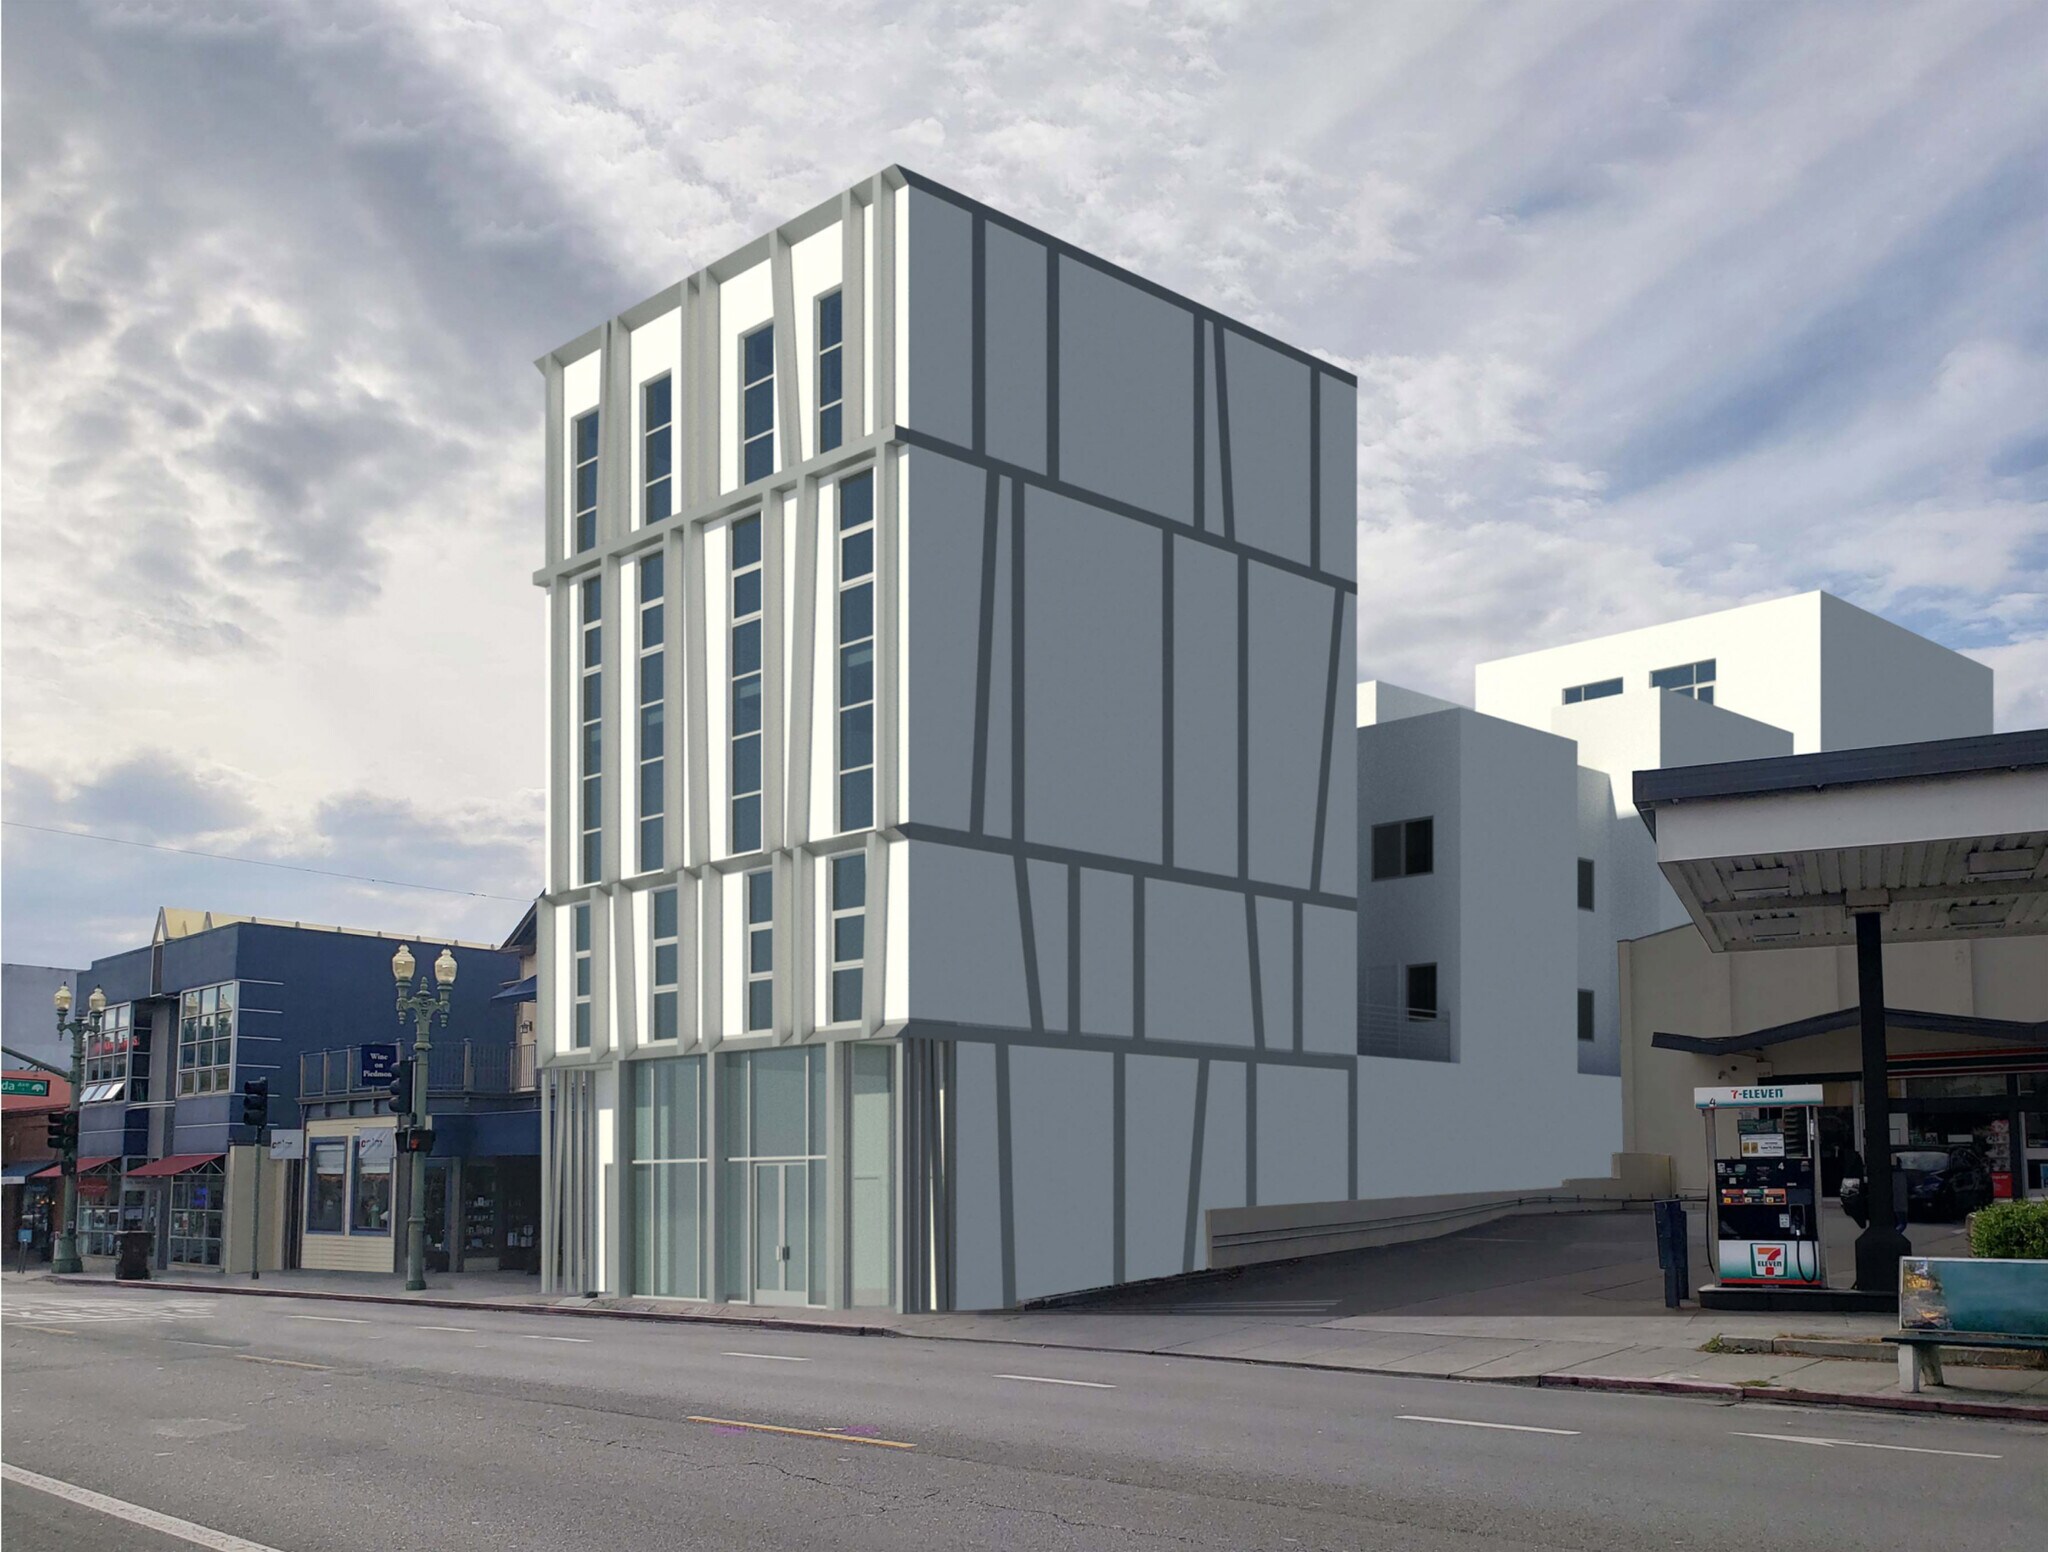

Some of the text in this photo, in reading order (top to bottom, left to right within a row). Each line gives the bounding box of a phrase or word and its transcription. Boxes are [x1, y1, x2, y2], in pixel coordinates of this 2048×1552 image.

[370, 1052, 388, 1060] Wine
[1709, 1097, 1716, 1107] 4
[1777, 1162, 1785, 1171] 4
